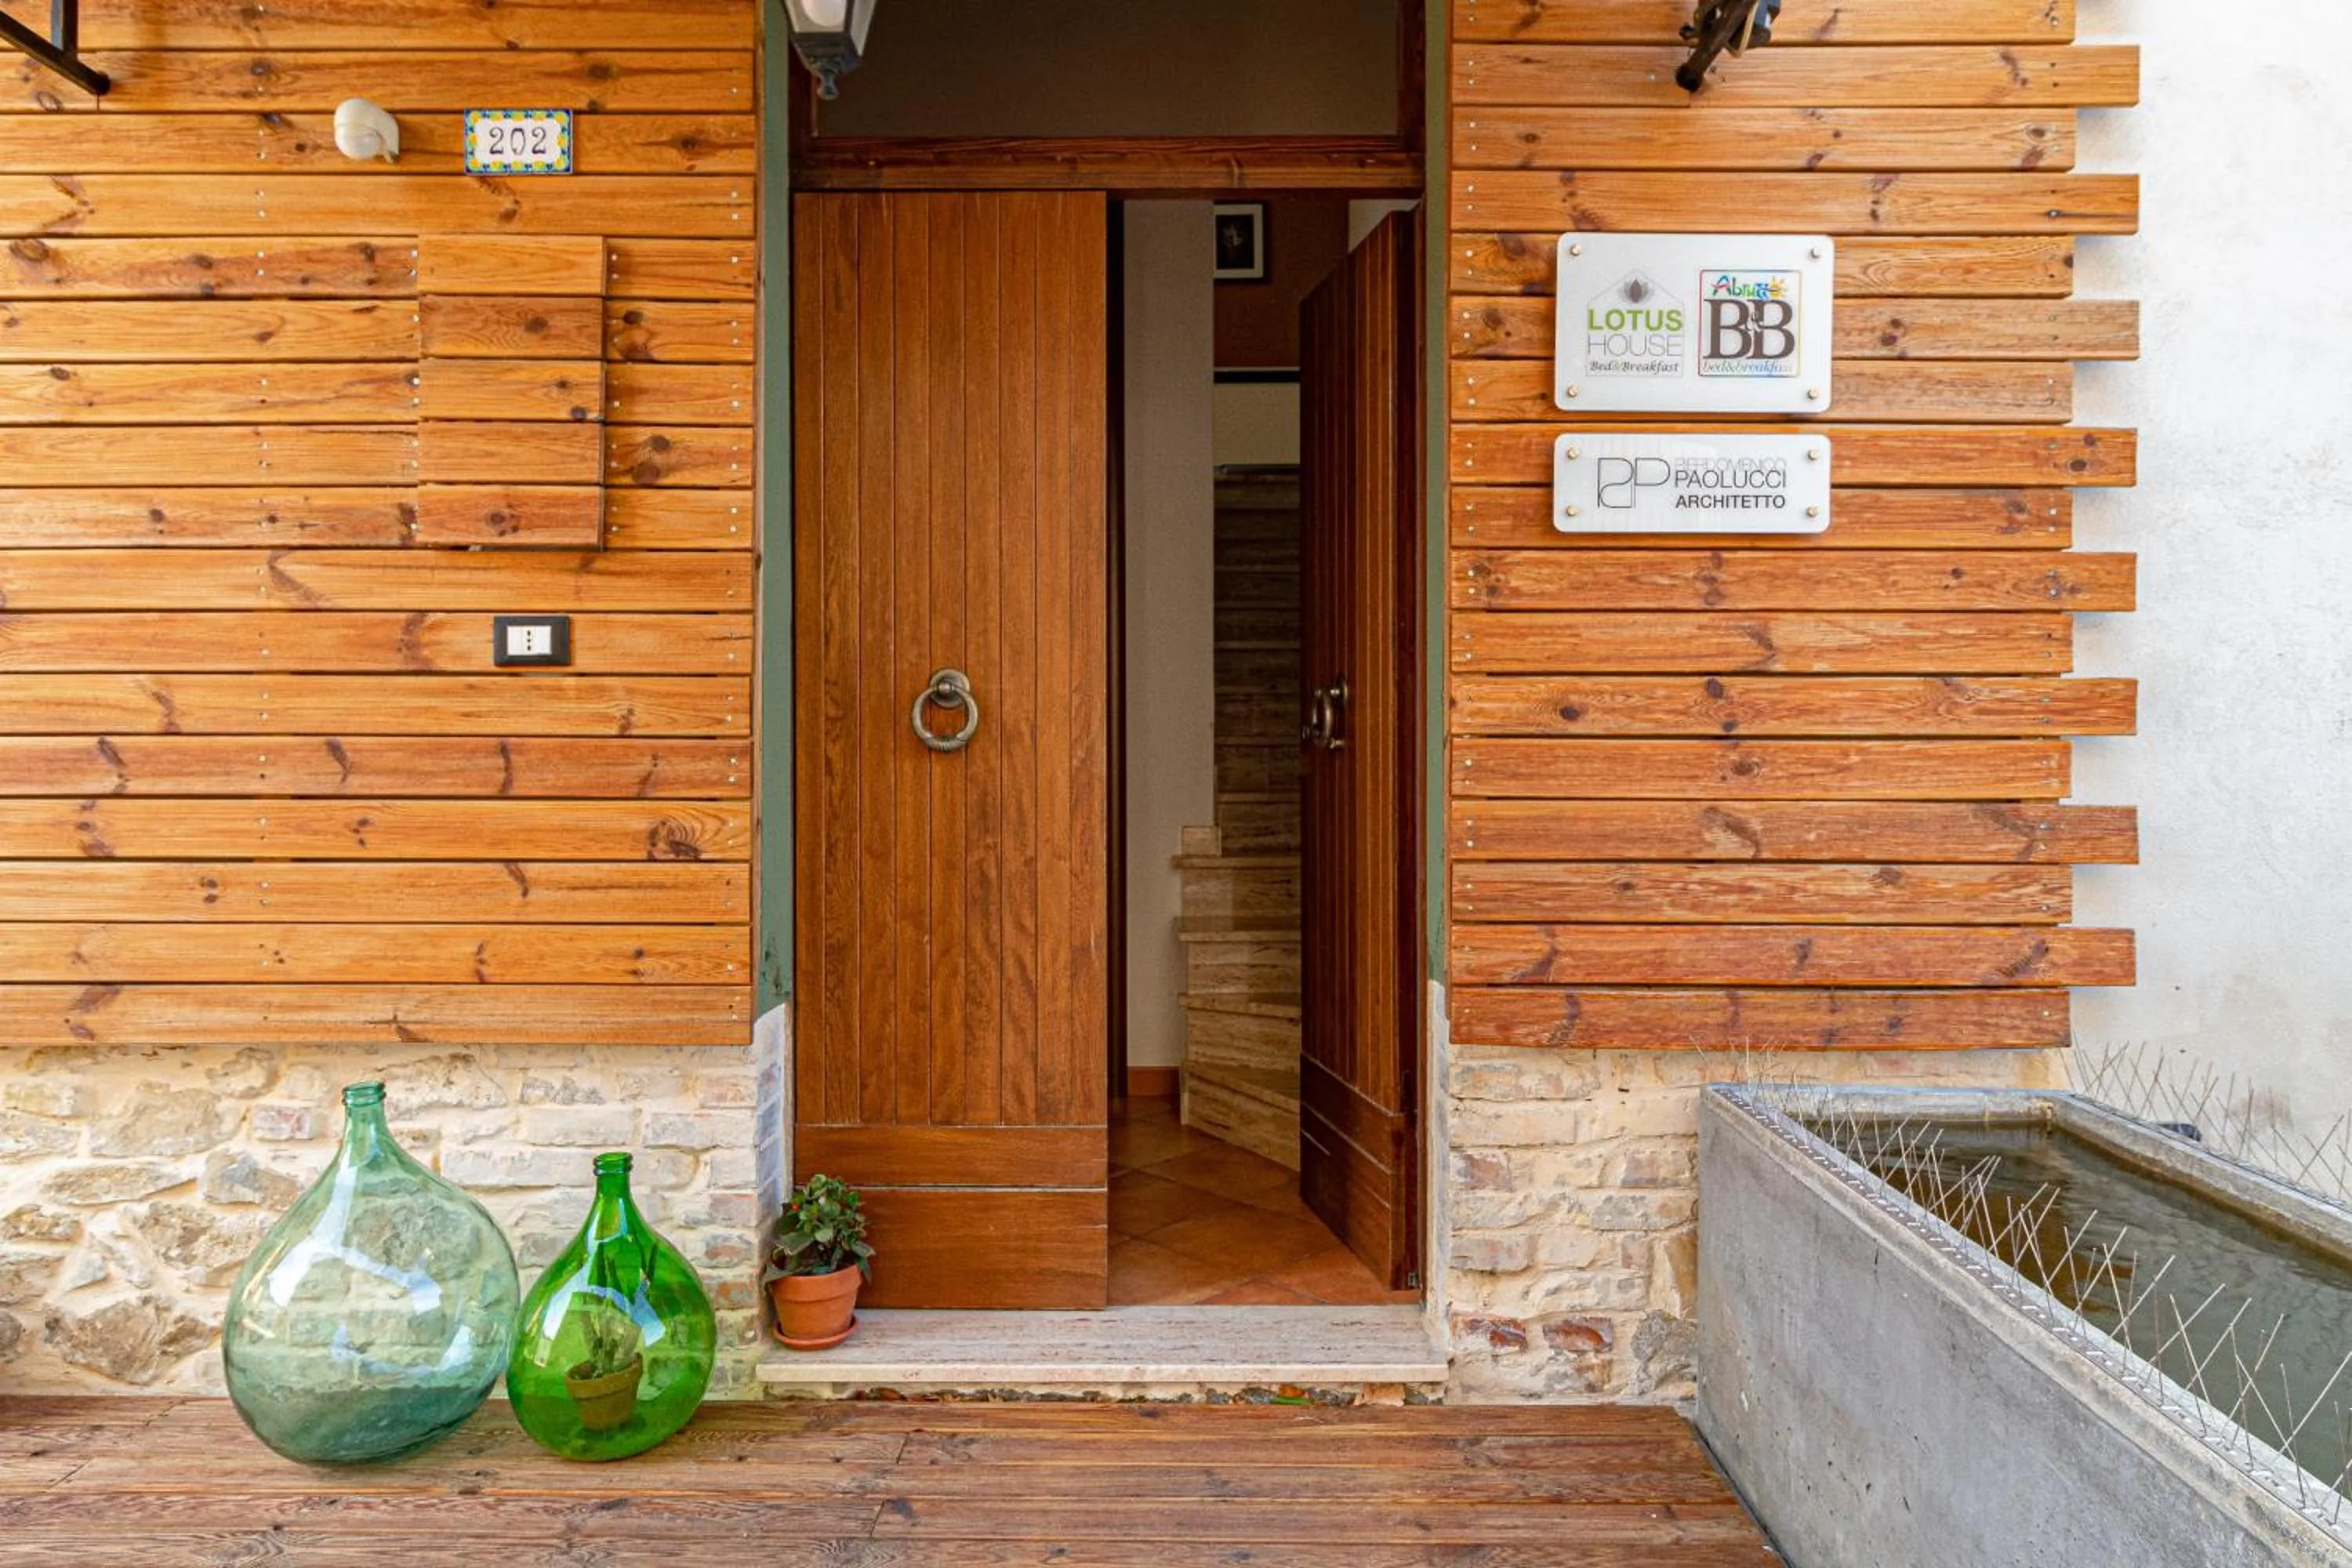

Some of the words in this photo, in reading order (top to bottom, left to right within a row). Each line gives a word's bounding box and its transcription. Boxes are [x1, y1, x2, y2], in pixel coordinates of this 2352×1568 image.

[488, 126, 546, 156] 202
[1588, 309, 1682, 331] LOTUS
[1587, 333, 1682, 357] HOUSE
[1674, 470, 1787, 488] PAOLUCCI
[1675, 495, 1786, 509] ARCHITETTO
